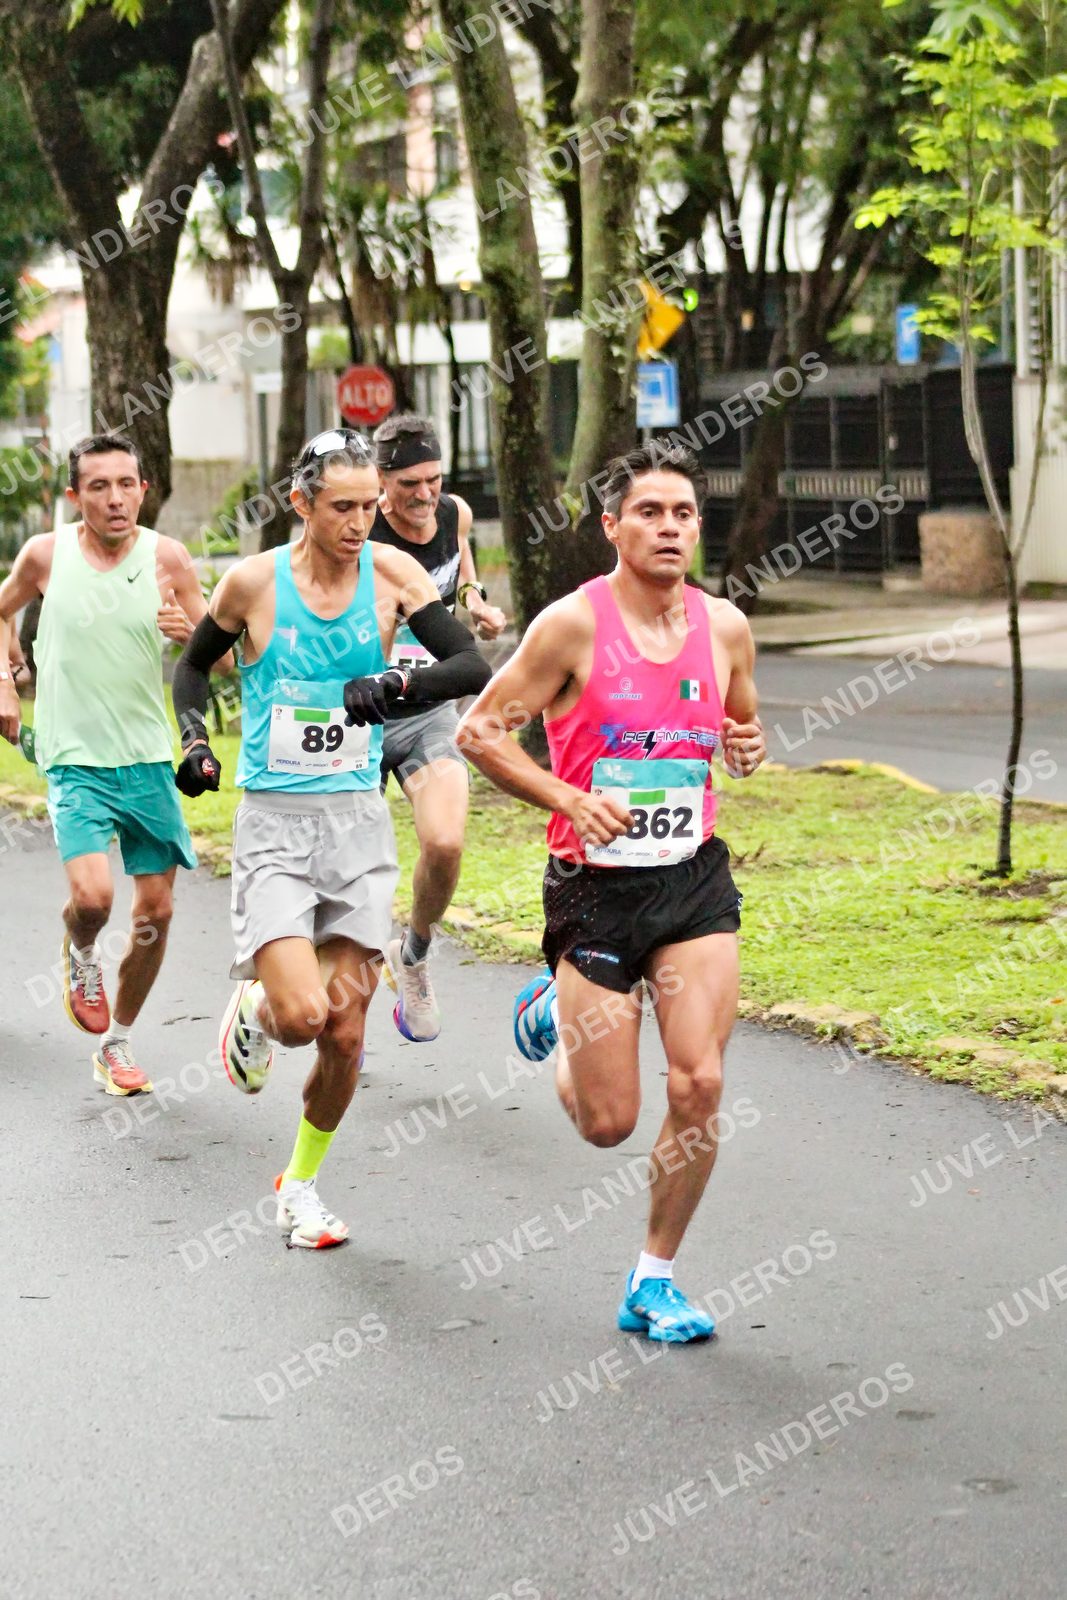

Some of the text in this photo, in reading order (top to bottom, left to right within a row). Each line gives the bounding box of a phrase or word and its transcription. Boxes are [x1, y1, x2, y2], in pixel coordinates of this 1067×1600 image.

[342, 383, 393, 408] ALTO
[301, 725, 344, 753] 89
[625, 807, 694, 840] 862
